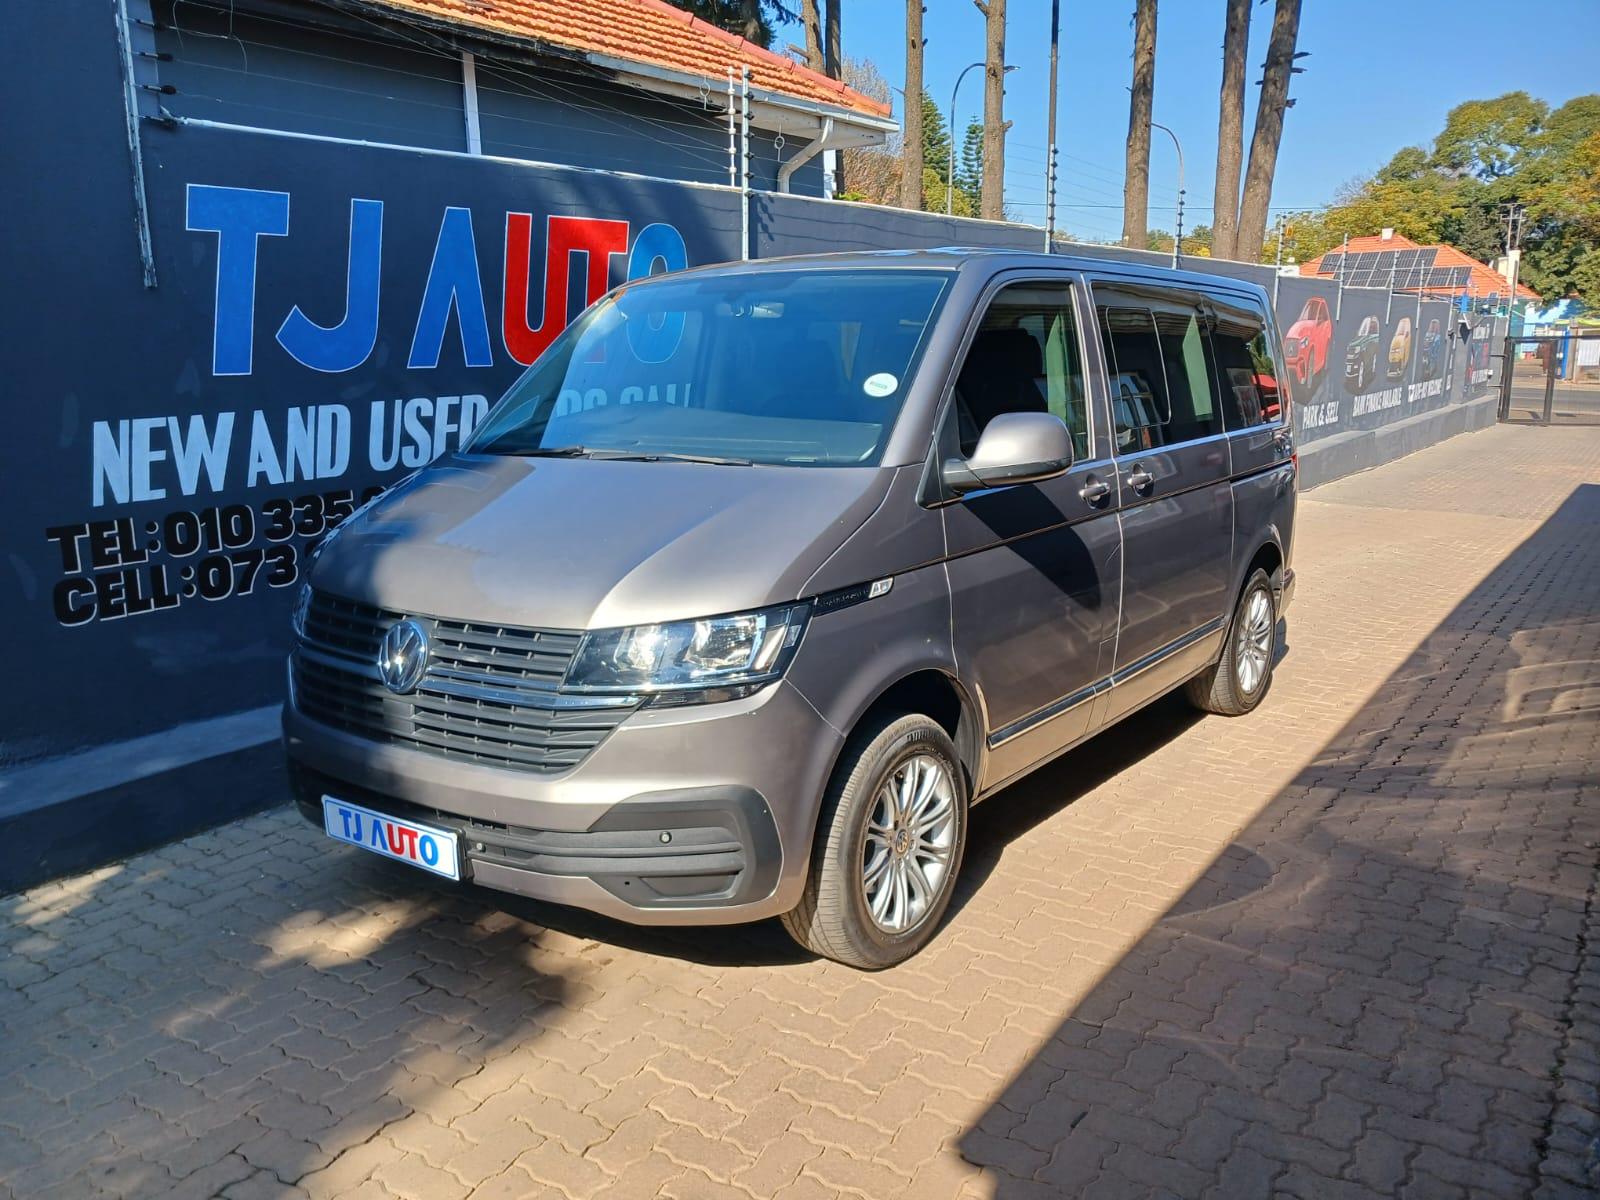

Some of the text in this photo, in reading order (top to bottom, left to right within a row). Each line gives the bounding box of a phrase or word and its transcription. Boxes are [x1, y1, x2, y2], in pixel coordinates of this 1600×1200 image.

[186, 183, 688, 375] TJ AUTO
[92, 411, 235, 507] NEW
[247, 404, 351, 488] AND
[46, 503, 255, 575] TEL:010
[53, 544, 299, 627] CELL:073
[339, 808, 439, 867] TJ AUTO
